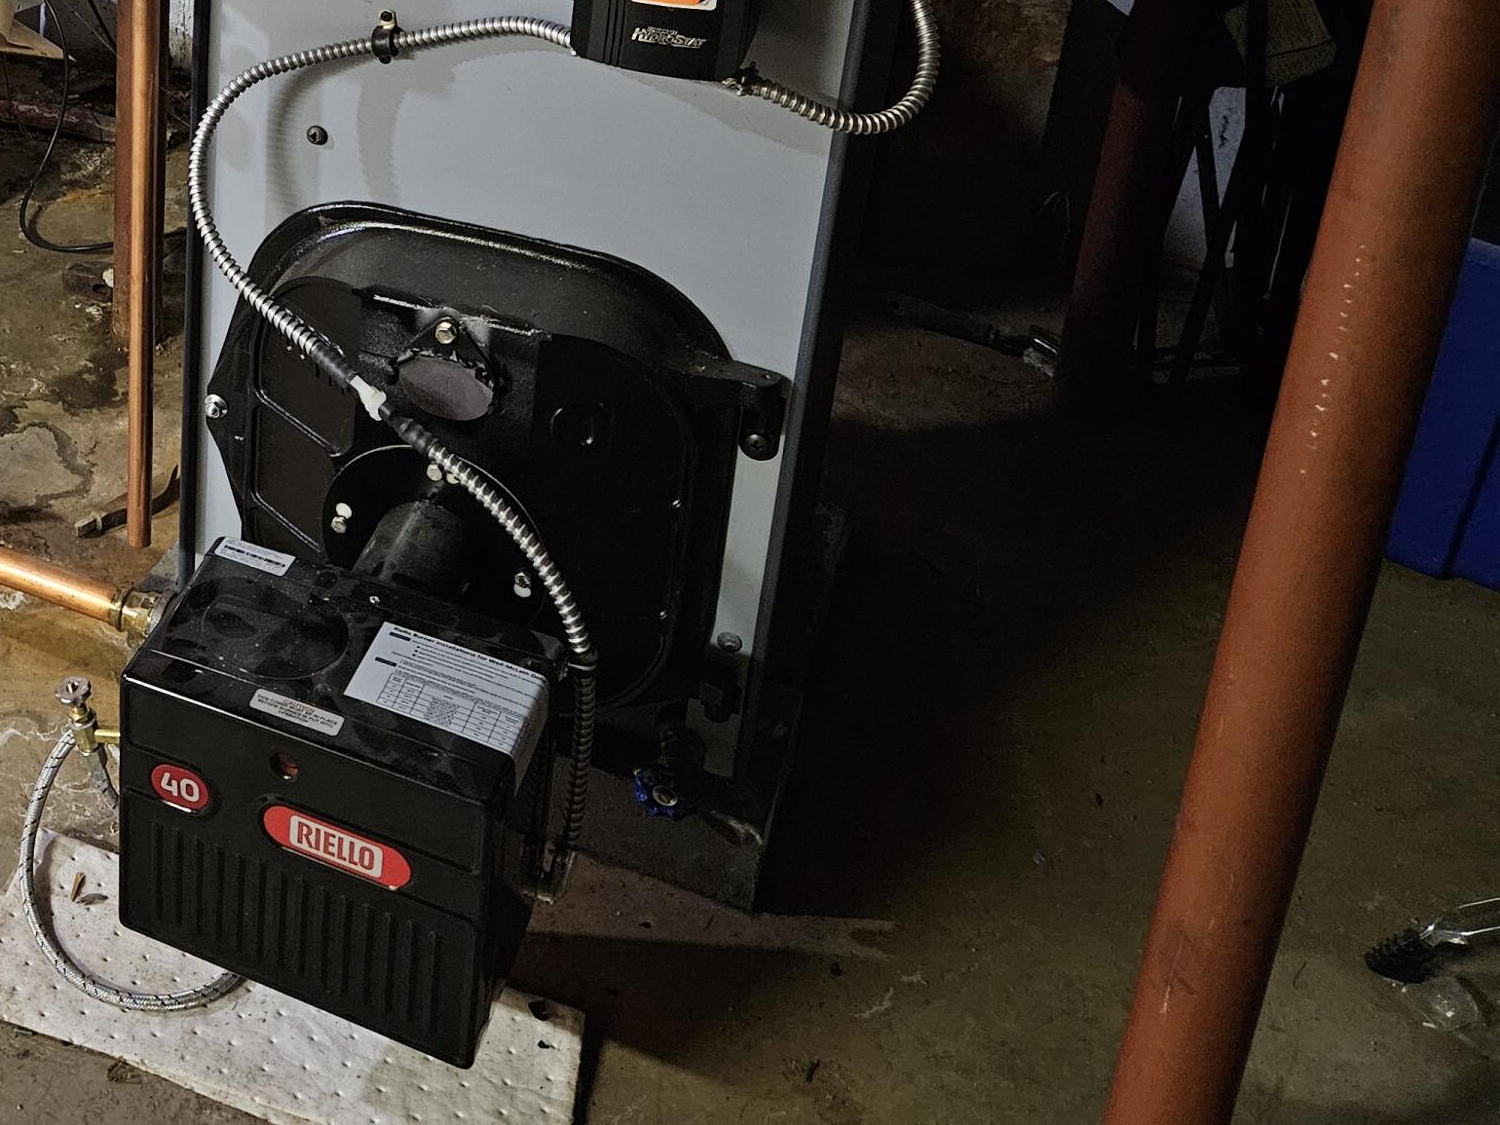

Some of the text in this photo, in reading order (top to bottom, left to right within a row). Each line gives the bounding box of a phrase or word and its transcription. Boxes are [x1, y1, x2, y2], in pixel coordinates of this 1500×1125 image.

[412, 633, 435, 643] Burner
[160, 771, 200, 803] 40
[296, 820, 376, 872] RIELLO
